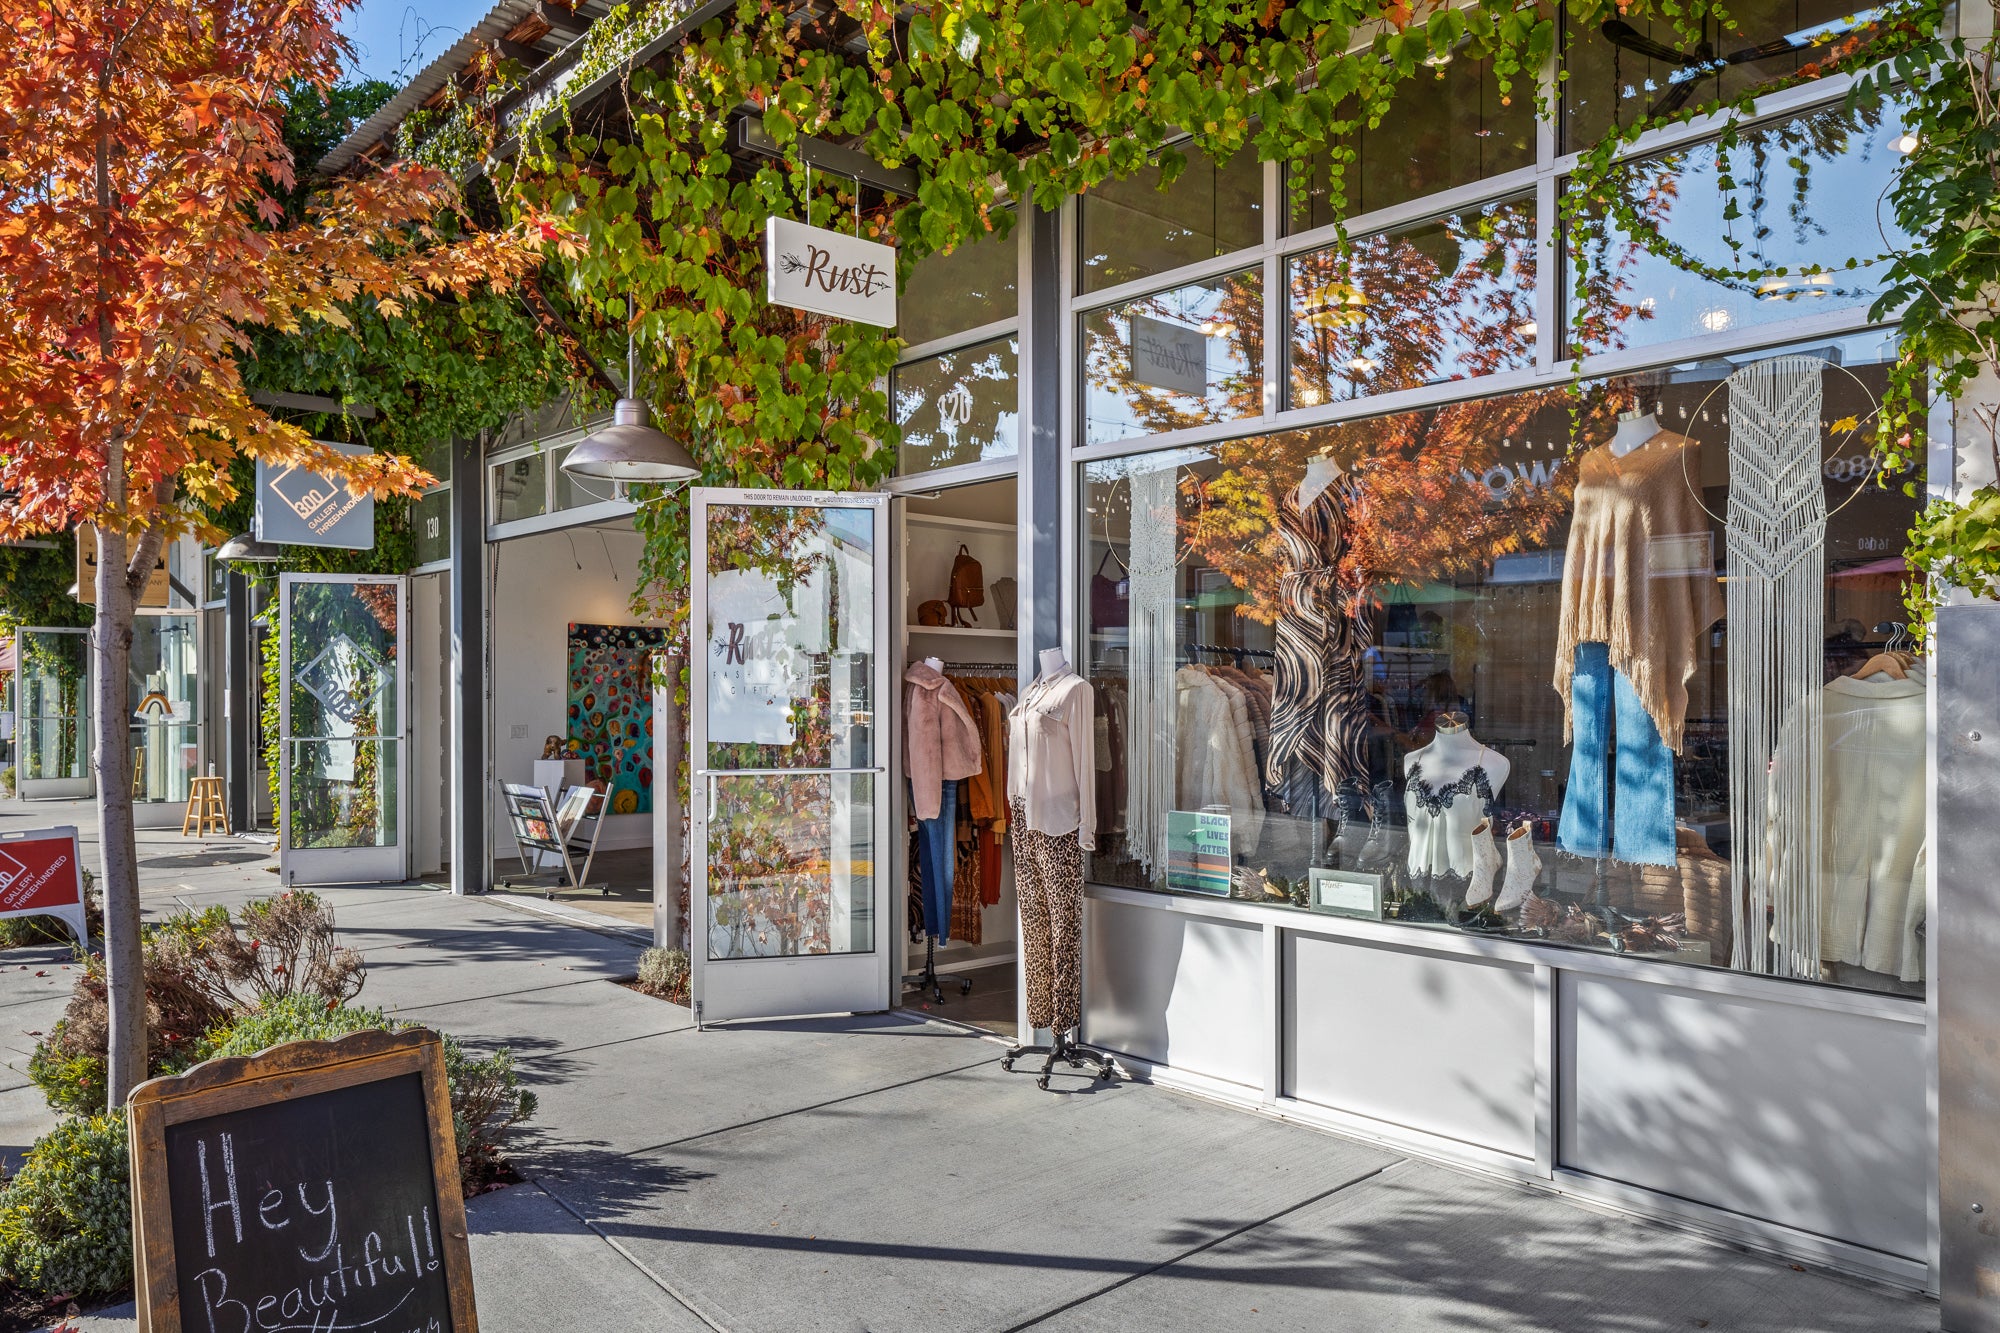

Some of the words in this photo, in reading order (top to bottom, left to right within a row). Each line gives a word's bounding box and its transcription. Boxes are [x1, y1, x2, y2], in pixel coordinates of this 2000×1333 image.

[805, 244, 888, 298] Rust
[938, 390, 971, 426] 120
[294, 489, 324, 517] 300
[743, 493, 754, 501] THIS
[773, 494, 790, 502] REMAIN
[308, 501, 338, 529] GALLERY
[427, 516, 439, 539] 130
[1200, 815, 1229, 827] BLACK
[1192, 843, 1229, 856] MATTER
[1206, 830, 1229, 841] LIVES
[4, 872, 35, 904] GALLERY
[12, 855, 67, 909] THREEHUNDRED
[197, 1132, 338, 1262] Hey
